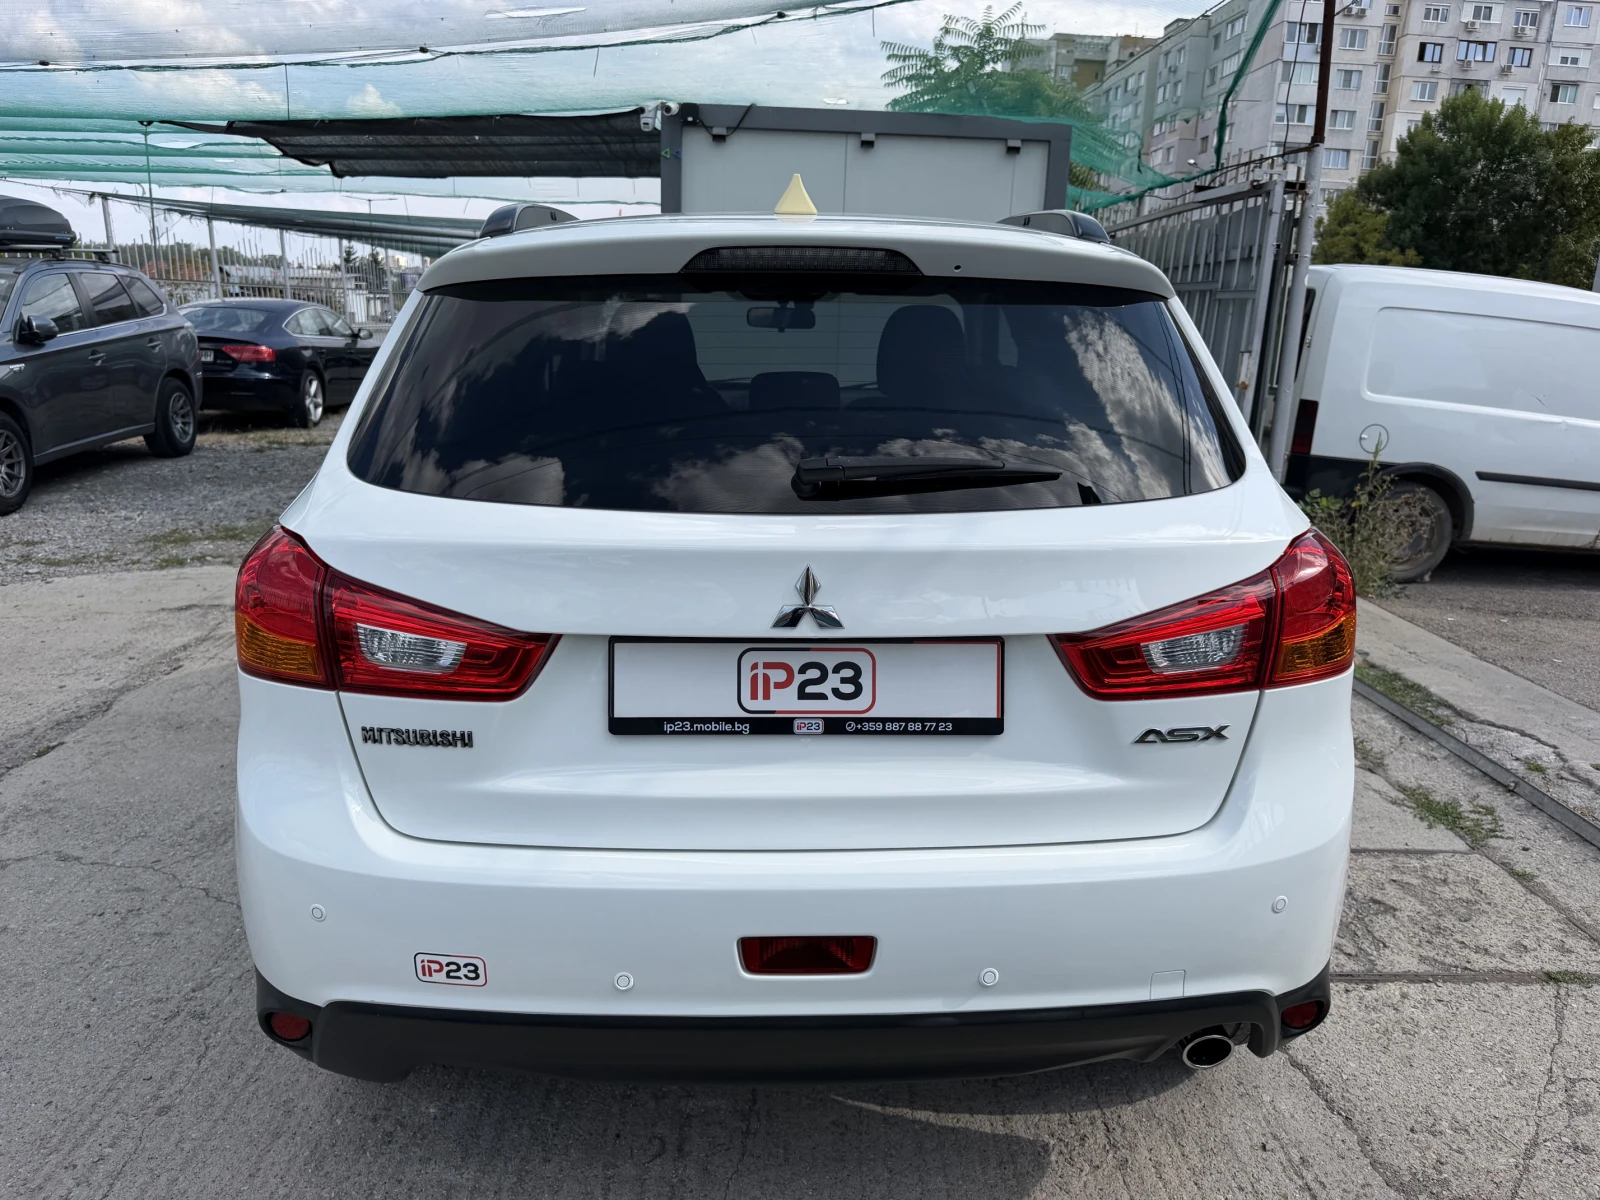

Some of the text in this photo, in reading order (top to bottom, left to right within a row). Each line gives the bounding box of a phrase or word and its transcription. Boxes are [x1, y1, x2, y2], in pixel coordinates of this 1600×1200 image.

[663, 721, 750, 734] ip23.mobile.bg
[856, 722, 953, 731] +359 887 88 77 23
[1131, 723, 1232, 744] ASX
[361, 726, 474, 748] MITSUBISHI
